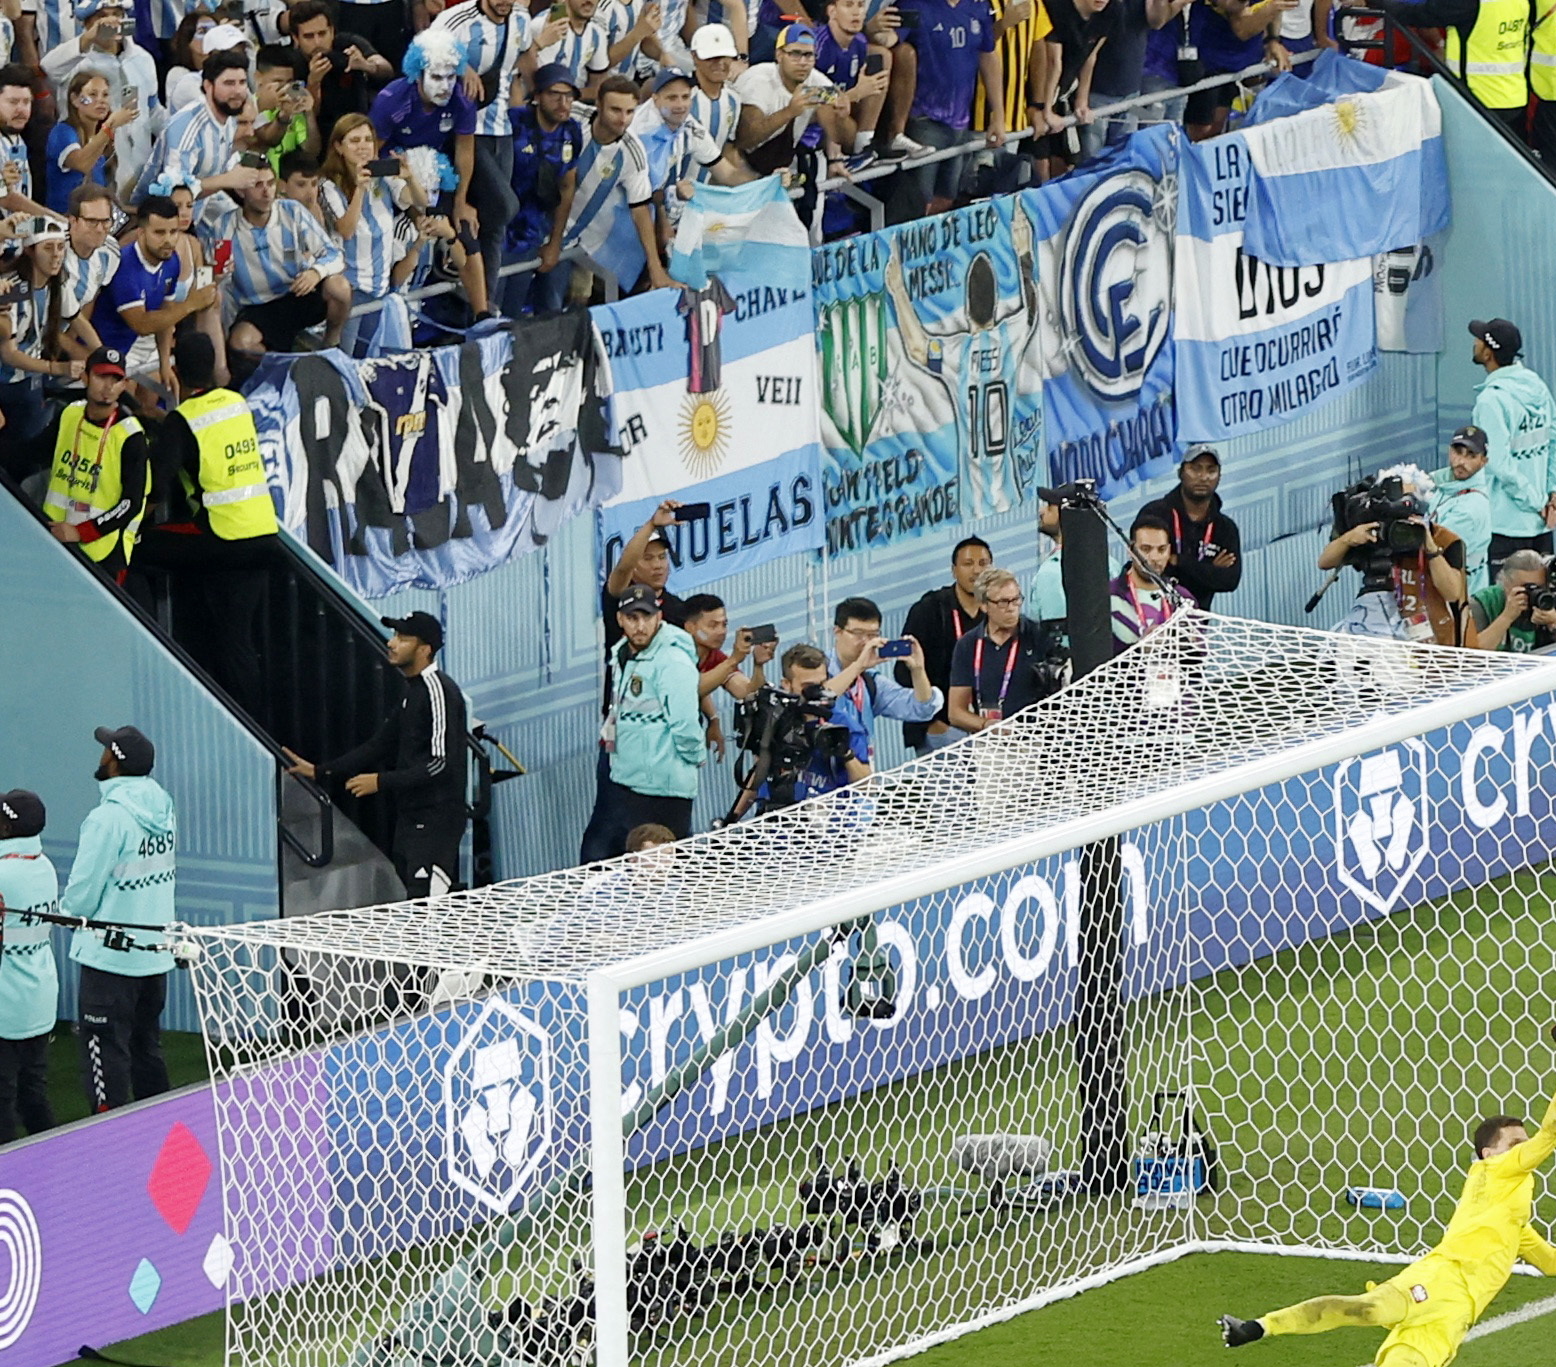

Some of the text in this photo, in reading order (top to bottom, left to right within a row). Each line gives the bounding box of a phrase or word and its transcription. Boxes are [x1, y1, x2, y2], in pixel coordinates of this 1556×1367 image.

[949, 27, 966, 49] 10
[1214, 144, 1240, 181] LA
[968, 204, 998, 244] LEO
[602, 322, 664, 359] BAUTI
[968, 380, 1008, 459] 10
[1220, 388, 1263, 428] OTRO
[138, 831, 174, 860] 4689
